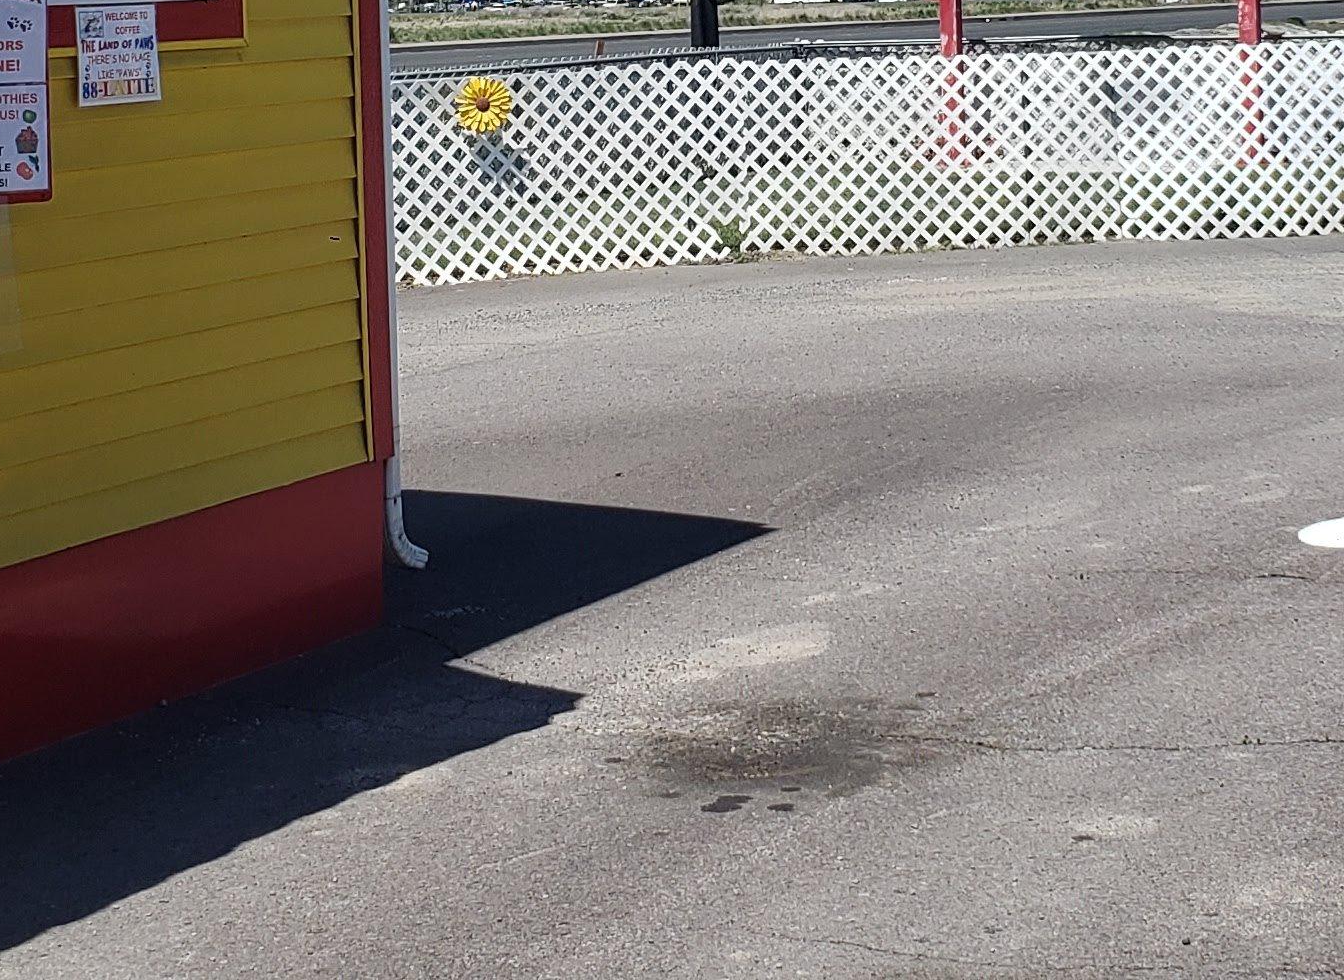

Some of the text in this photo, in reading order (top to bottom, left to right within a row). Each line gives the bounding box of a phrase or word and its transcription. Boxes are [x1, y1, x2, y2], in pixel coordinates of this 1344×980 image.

[105, 11, 148, 21] WELCOME TO
[115, 25, 140, 35] COFFEE
[81, 35, 154, 53] THE LAND OF PAWS
[118, 54, 130, 63] NO
[98, 69, 114, 80] LIKE
[82, 78, 155, 100] 88-LATTE
